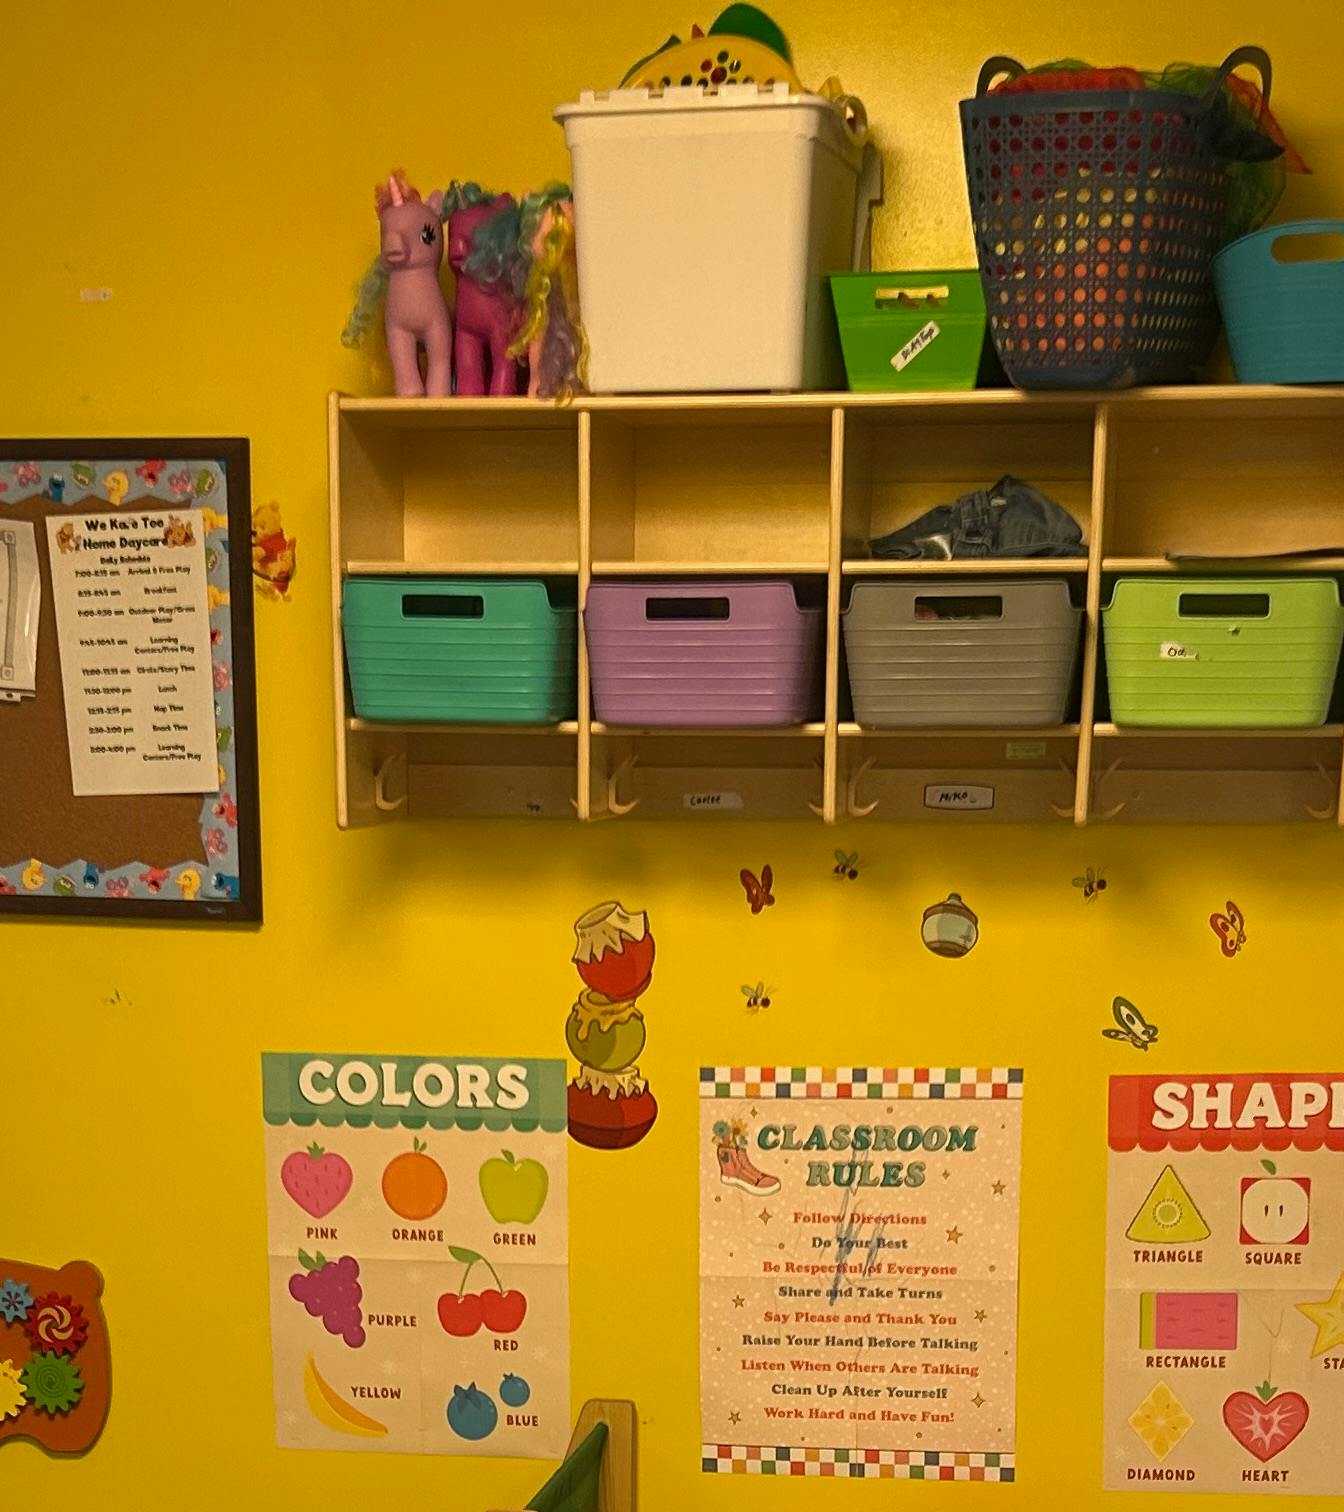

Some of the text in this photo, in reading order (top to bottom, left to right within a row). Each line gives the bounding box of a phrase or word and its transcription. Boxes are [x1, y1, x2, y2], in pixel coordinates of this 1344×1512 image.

[85, 520, 106, 531] We
[83, 536, 168, 550] Home Daycare
[298, 1058, 530, 1111] COLORS
[757, 1123, 979, 1152] CLASSROOM
[805, 1160, 927, 1189] RULES
[793, 1211, 927, 1226] Follow Directions
[306, 1226, 338, 1241] PINK
[391, 1227, 444, 1243] ORANGE
[493, 1231, 536, 1246] GREEN
[811, 1236, 908, 1250] Do Your Best
[1133, 1248, 1204, 1263] TRIANGLE
[1244, 1251, 1302, 1266] SQUARE
[762, 1261, 958, 1278] Be Respectful of Everyone
[778, 1286, 943, 1300] Share and Take Turns
[367, 1313, 417, 1328] PURPLE
[763, 1311, 958, 1327] Say Please and Thank You
[493, 1339, 518, 1352] RED
[742, 1335, 978, 1352] Raise Your Hand Before Talking
[741, 1359, 980, 1377] Listen When Others Are Talking
[1145, 1354, 1227, 1370] RECTANGLE
[350, 1385, 402, 1400] YELLOW
[771, 1384, 948, 1399] Clean Up After Yourself
[506, 1414, 539, 1428] BLUE
[763, 1407, 955, 1423] Work Hard and Have Fun!
[1127, 1468, 1196, 1481] DIAMOND
[1241, 1469, 1289, 1483] HEART
